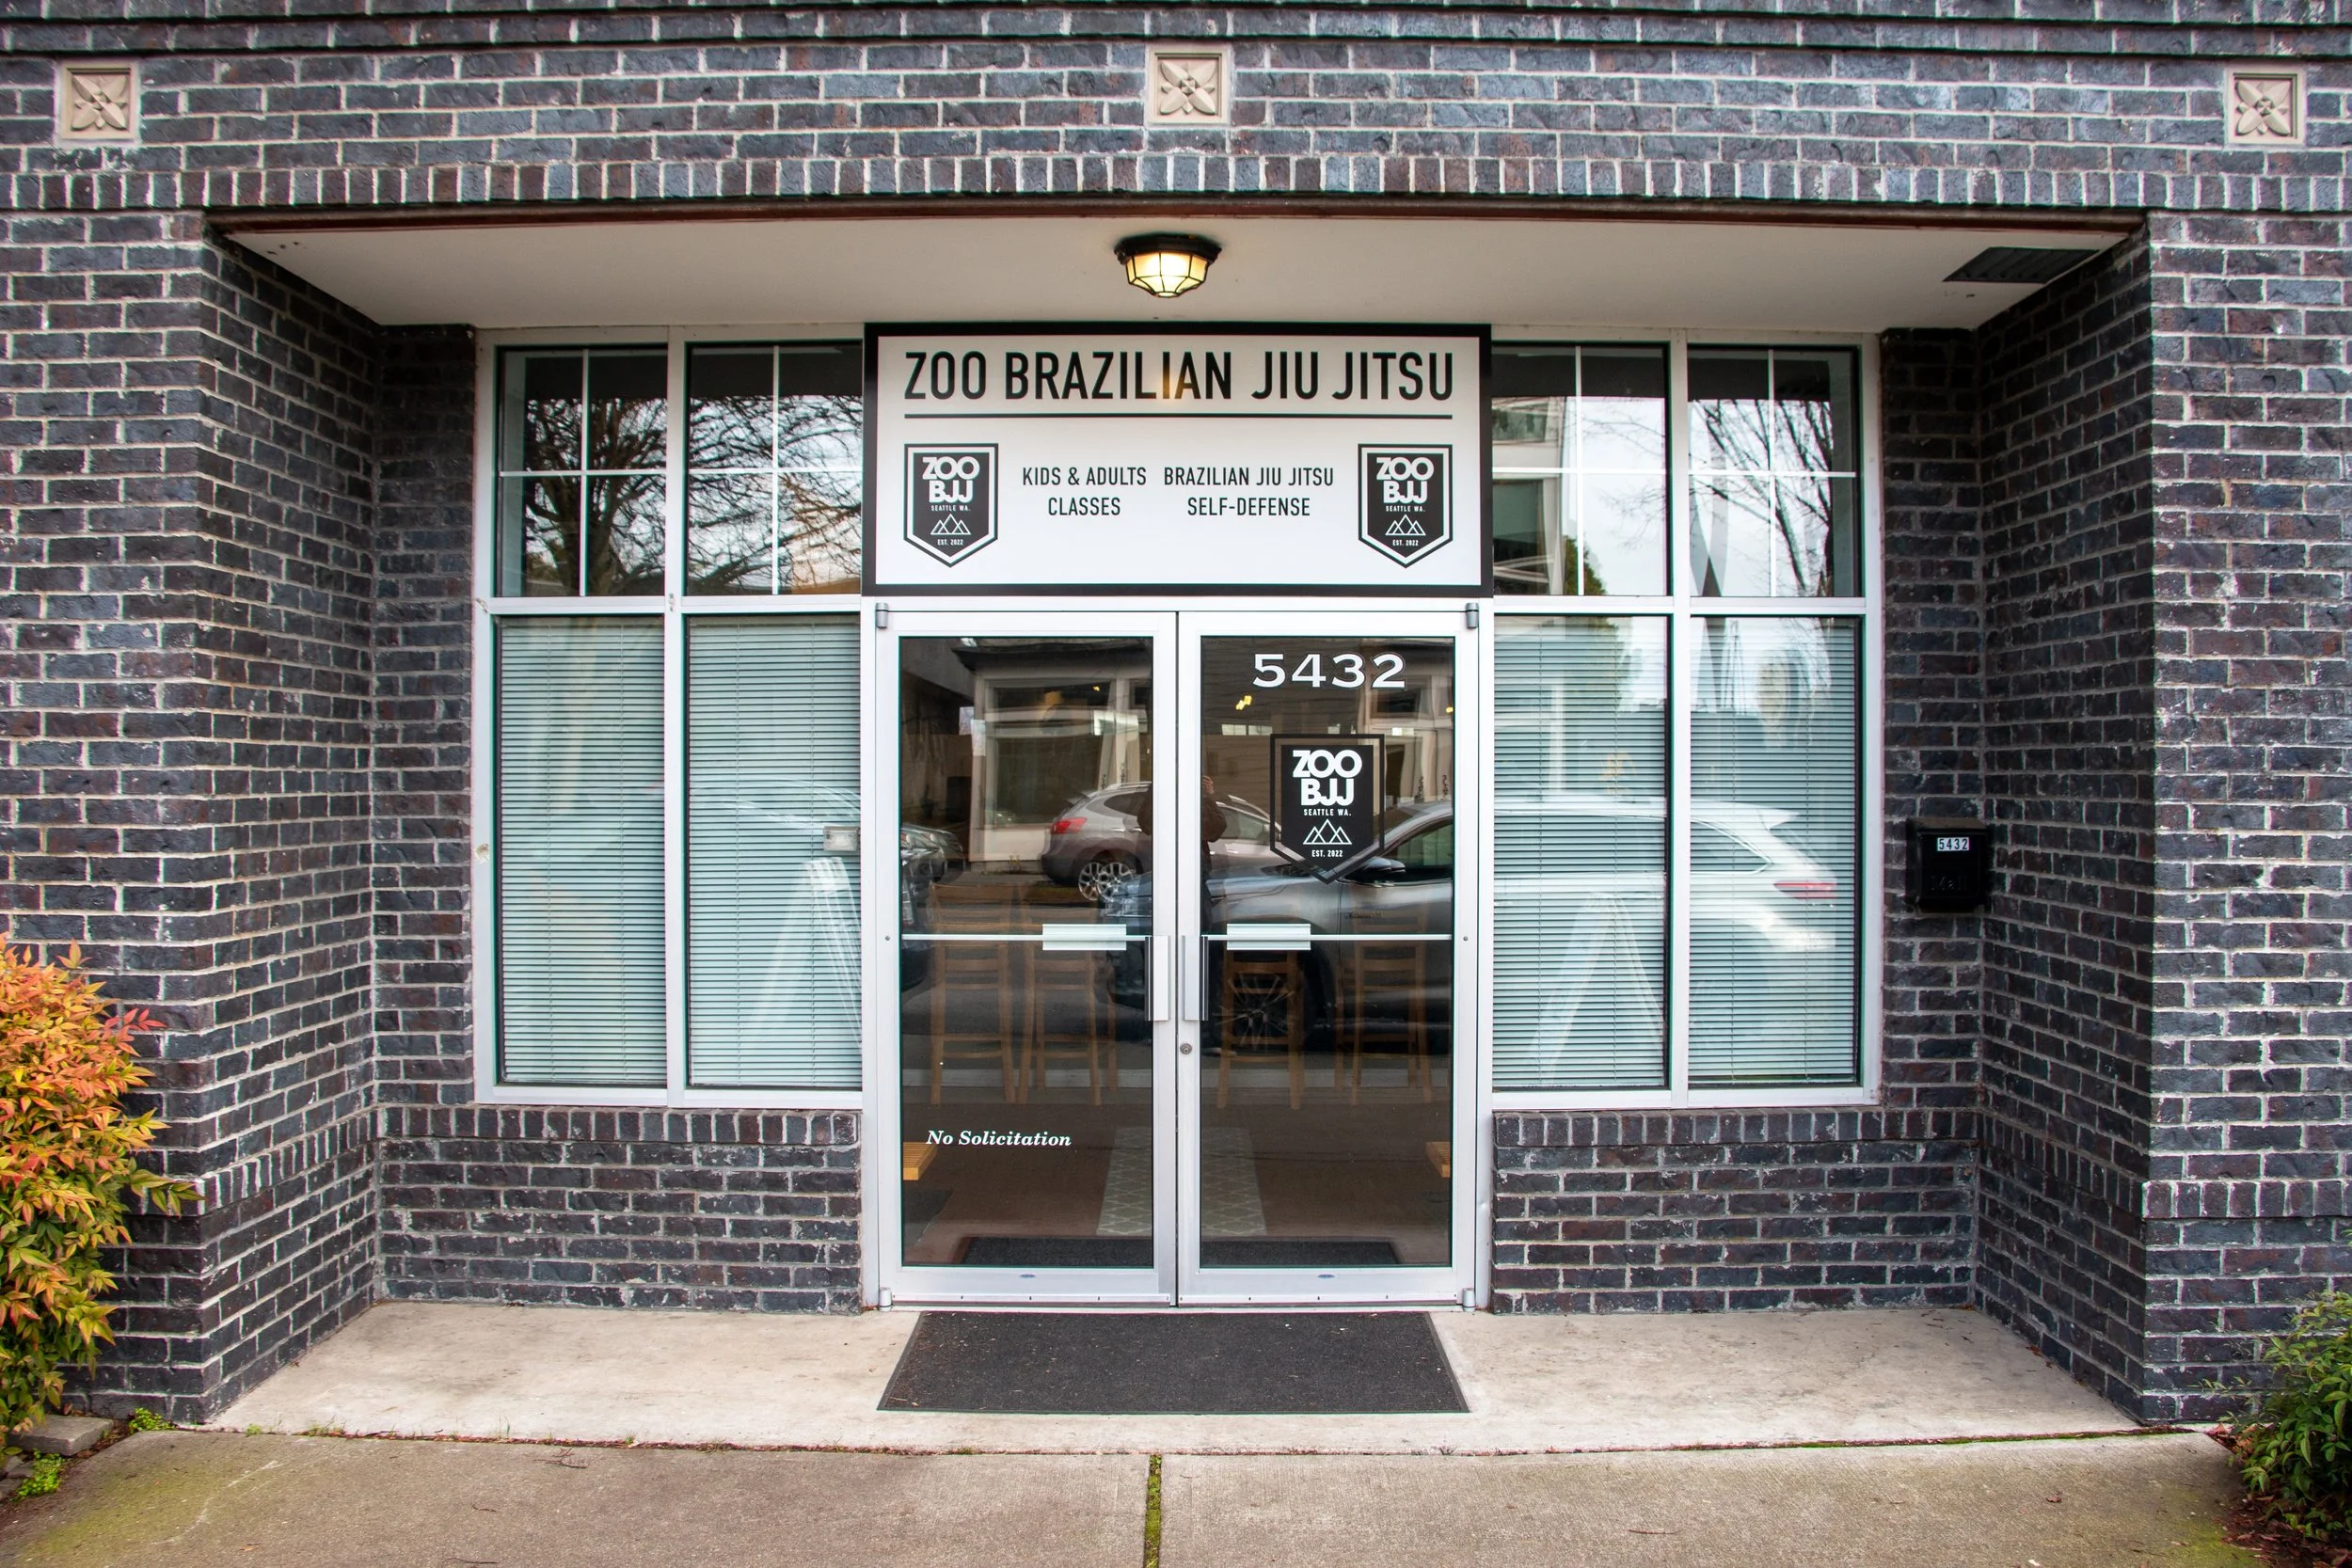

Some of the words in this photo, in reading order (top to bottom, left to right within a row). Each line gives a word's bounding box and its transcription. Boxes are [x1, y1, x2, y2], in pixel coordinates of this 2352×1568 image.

[905, 351, 987, 400] ZOO
[1006, 351, 1232, 400] BRAZILIAN
[1252, 351, 1319, 400] JIU
[1332, 351, 1453, 401] JITSU
[922, 456, 980, 481] ZOO
[1023, 467, 1061, 485] KIDS
[1068, 467, 1080, 485] &
[1086, 467, 1147, 485] ADULTS
[1165, 467, 1249, 486] BRAZILIAN
[1256, 467, 1281, 486] JIU
[1288, 467, 1334, 486] JITSU
[1376, 456, 1435, 481] ZOO
[929, 480, 974, 503] BJJ
[1383, 481, 1428, 504] BJJ
[1048, 497, 1120, 516] CLASSES
[1187, 497, 1311, 516] SELF-DEFENSE
[1252, 653, 1406, 689] 5432
[1293, 749, 1363, 778] ZOO
[1300, 778, 1355, 806] BJJ
[1303, 808, 1334, 816] SEATTLE
[1337, 808, 1352, 816] WA.
[1311, 849, 1326, 858] EST.
[1327, 849, 1343, 858] 2022
[1938, 838, 1968, 850] 5432
[925, 1130, 954, 1145] No
[958, 1130, 1072, 1147] Solicitation
